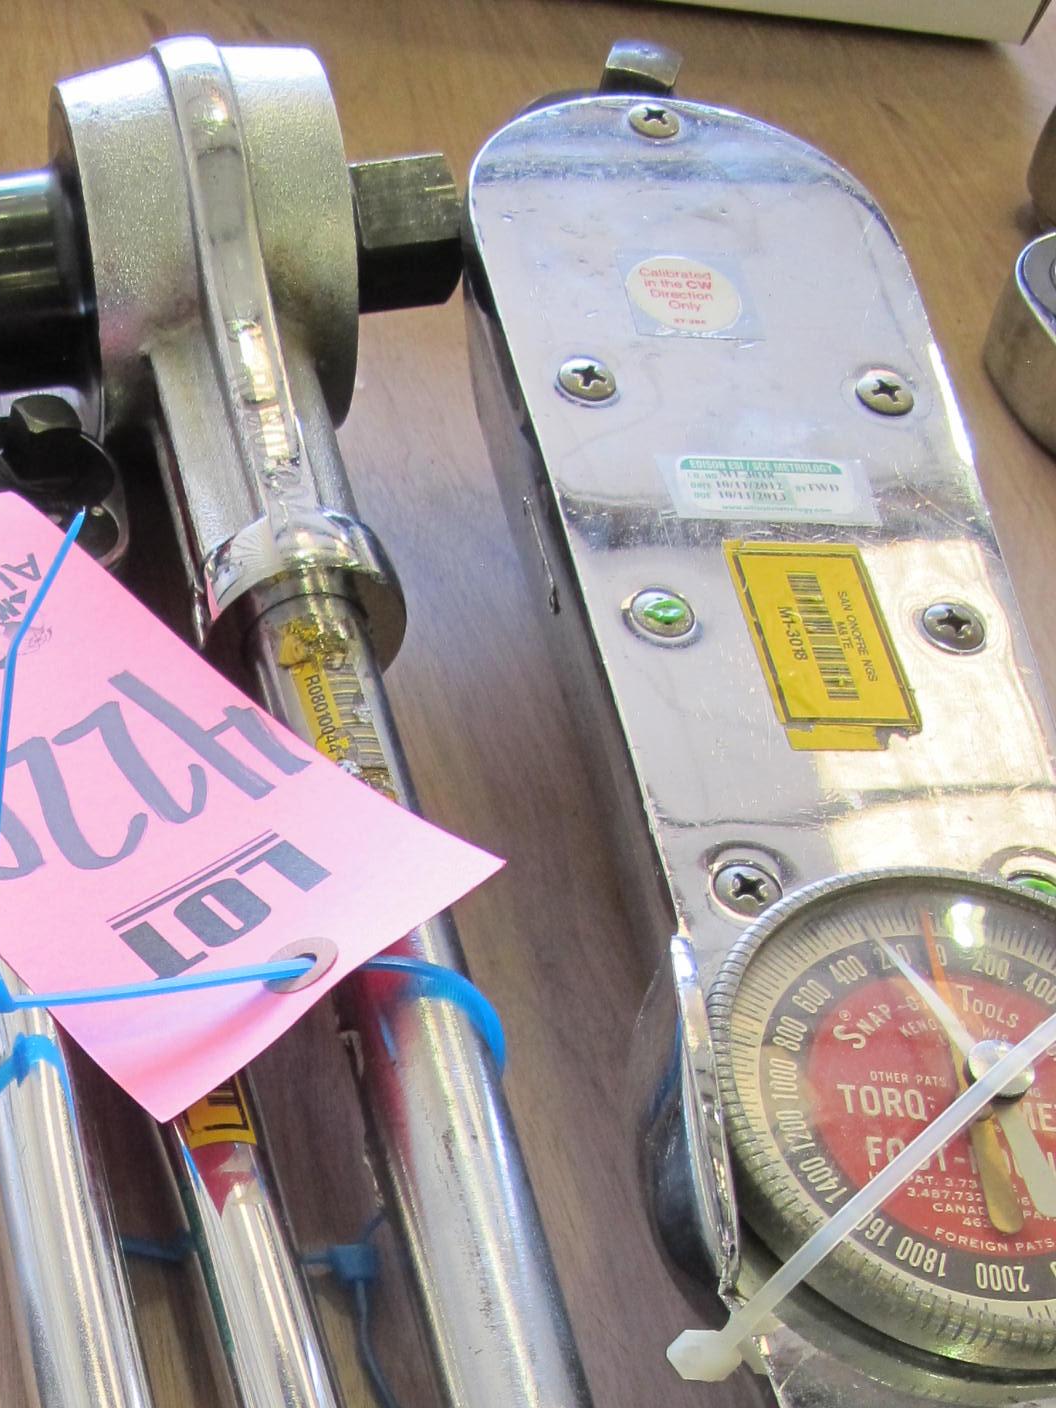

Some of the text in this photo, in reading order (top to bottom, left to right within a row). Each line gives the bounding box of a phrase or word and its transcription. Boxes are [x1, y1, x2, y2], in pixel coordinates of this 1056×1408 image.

[639, 267, 711, 280] Calibrated
[660, 280, 682, 289] the
[686, 280, 712, 291] CW
[650, 289, 714, 301] Direction
[668, 300, 701, 312] Only
[838, 591, 852, 611] SAN
[846, 615, 869, 656] ONOFRE
[119, 838, 332, 979] LOT
[829, 955, 869, 985] 400
[971, 952, 1011, 981] 200
[792, 979, 832, 1015] 600
[954, 984, 1020, 1029] TOOLS
[772, 1015, 808, 1051] 800
[769, 1058, 800, 1101] 1000
[870, 1070, 909, 1084] OTHER
[776, 1110, 816, 1153] 1200
[799, 1156, 848, 1205] 1400
[934, 1227, 1009, 1252] FOREIGN
[895, 1236, 948, 1278] 1800
[975, 1262, 1031, 1292] 2000
